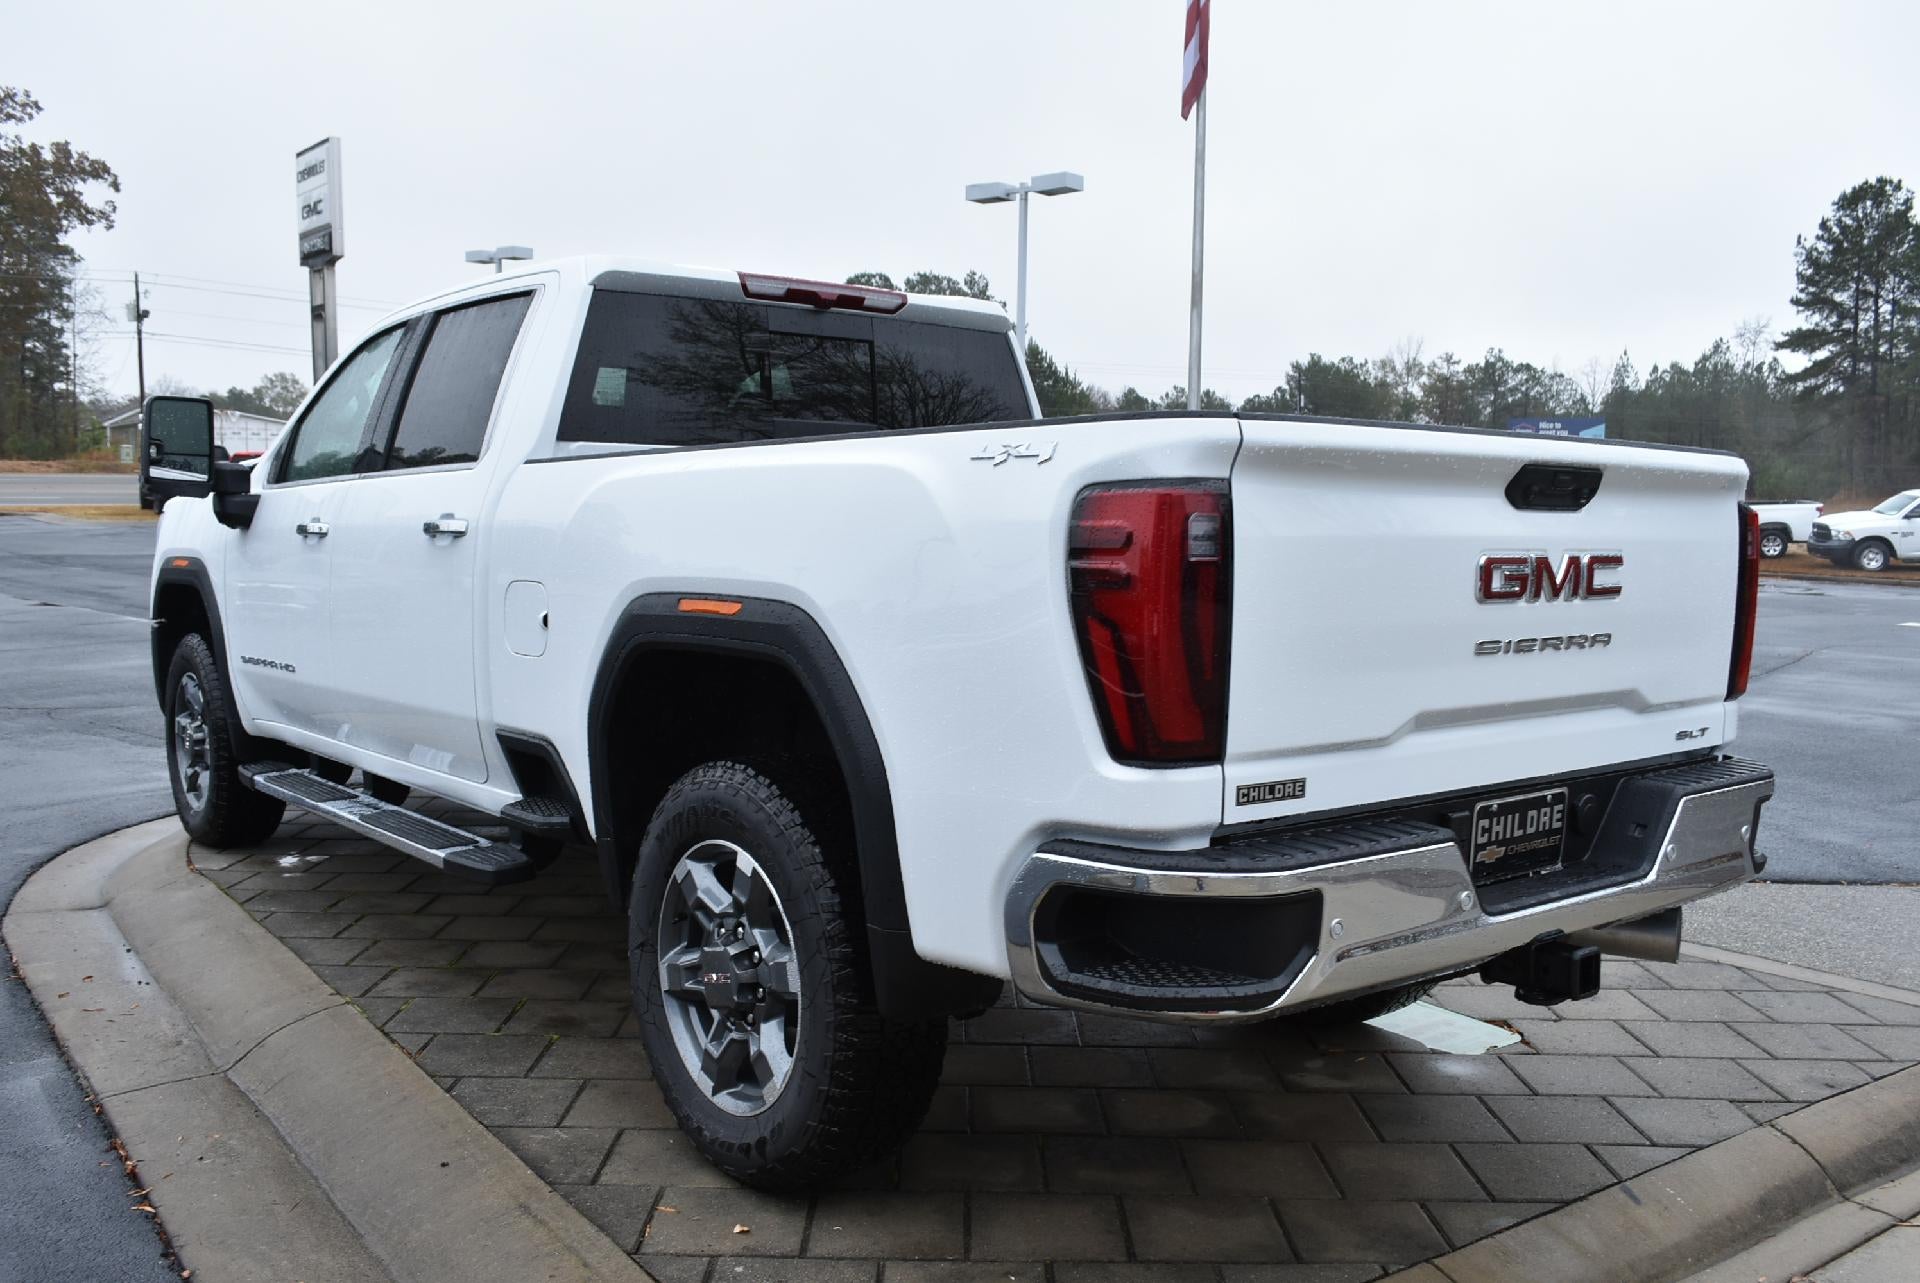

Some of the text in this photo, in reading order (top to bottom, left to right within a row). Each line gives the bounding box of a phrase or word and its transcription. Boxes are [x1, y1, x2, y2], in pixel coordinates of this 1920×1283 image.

[302, 199, 323, 220] GMC
[1539, 421, 1554, 429] Nice
[1475, 550, 1624, 604] GMC
[1474, 632, 1612, 656] SIERRA
[1675, 726, 1710, 741] SLT
[1239, 782, 1304, 803] CHILDRE
[1476, 803, 1564, 845] CHILDRE
[1506, 835, 1562, 855] CHEVROLET
